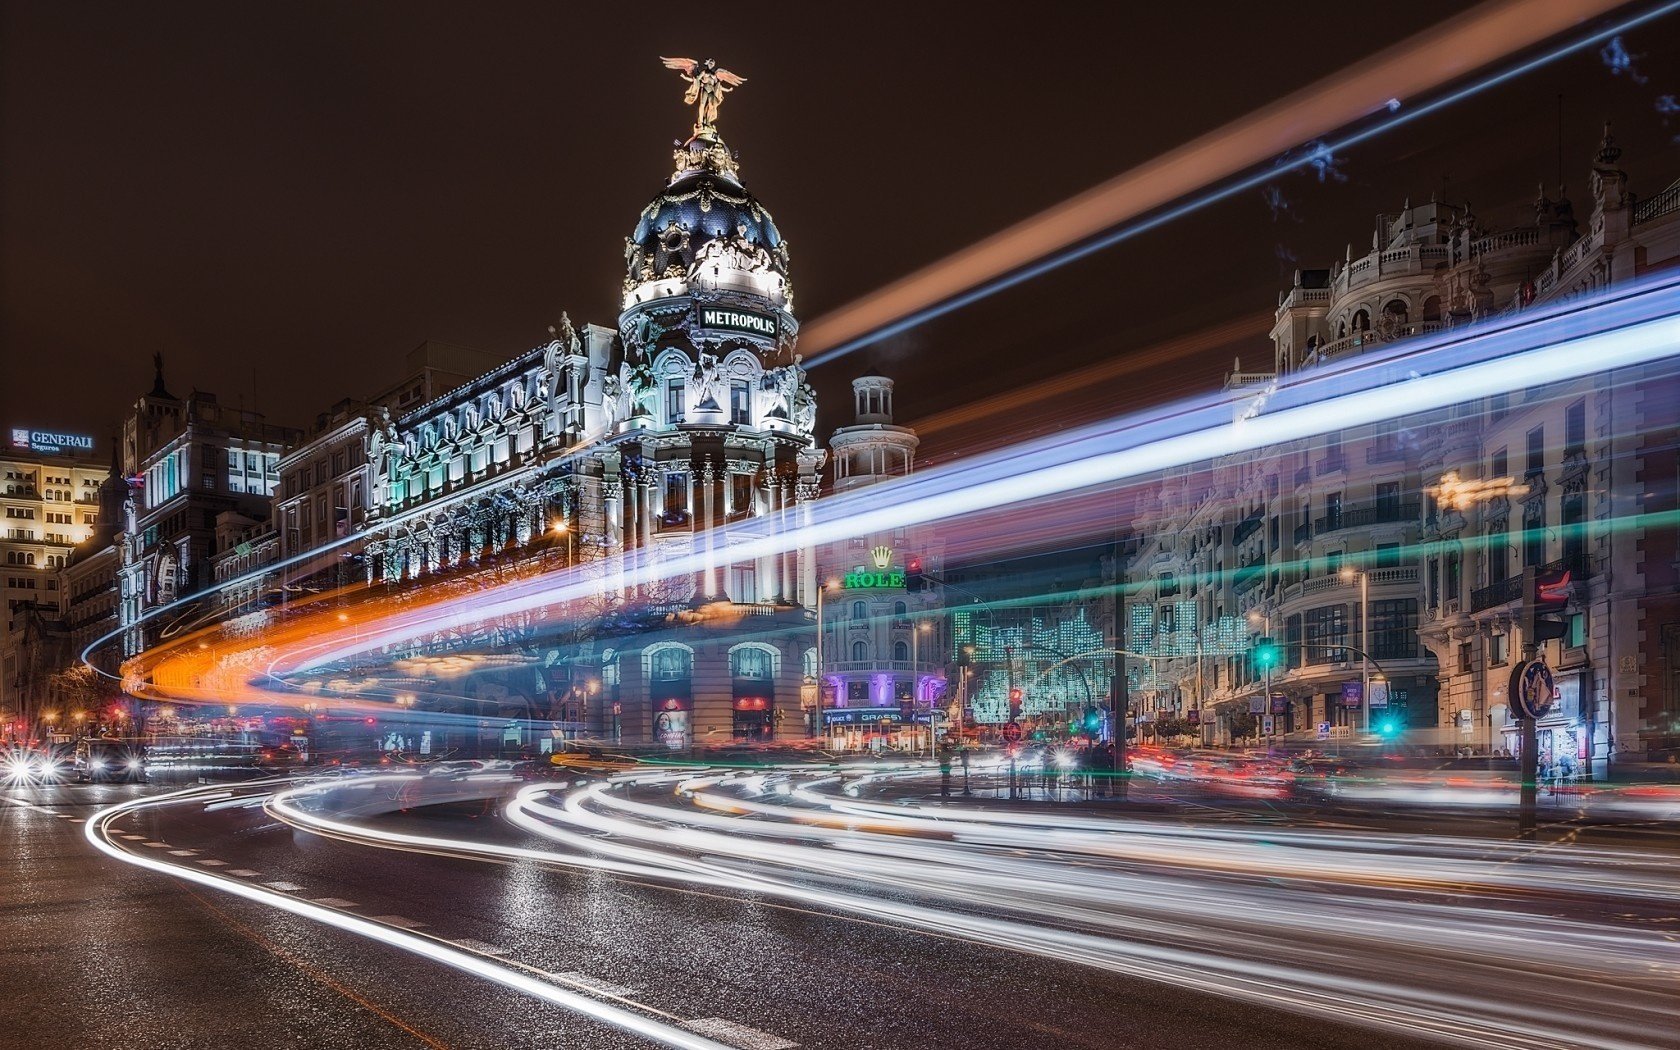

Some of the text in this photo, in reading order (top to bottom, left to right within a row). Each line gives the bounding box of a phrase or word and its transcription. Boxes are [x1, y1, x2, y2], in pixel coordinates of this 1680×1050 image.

[704, 311, 775, 334] METROPOLIS
[31, 431, 93, 448] GENERALI
[31, 442, 60, 452] Seguros
[845, 573, 906, 588] ROLE
